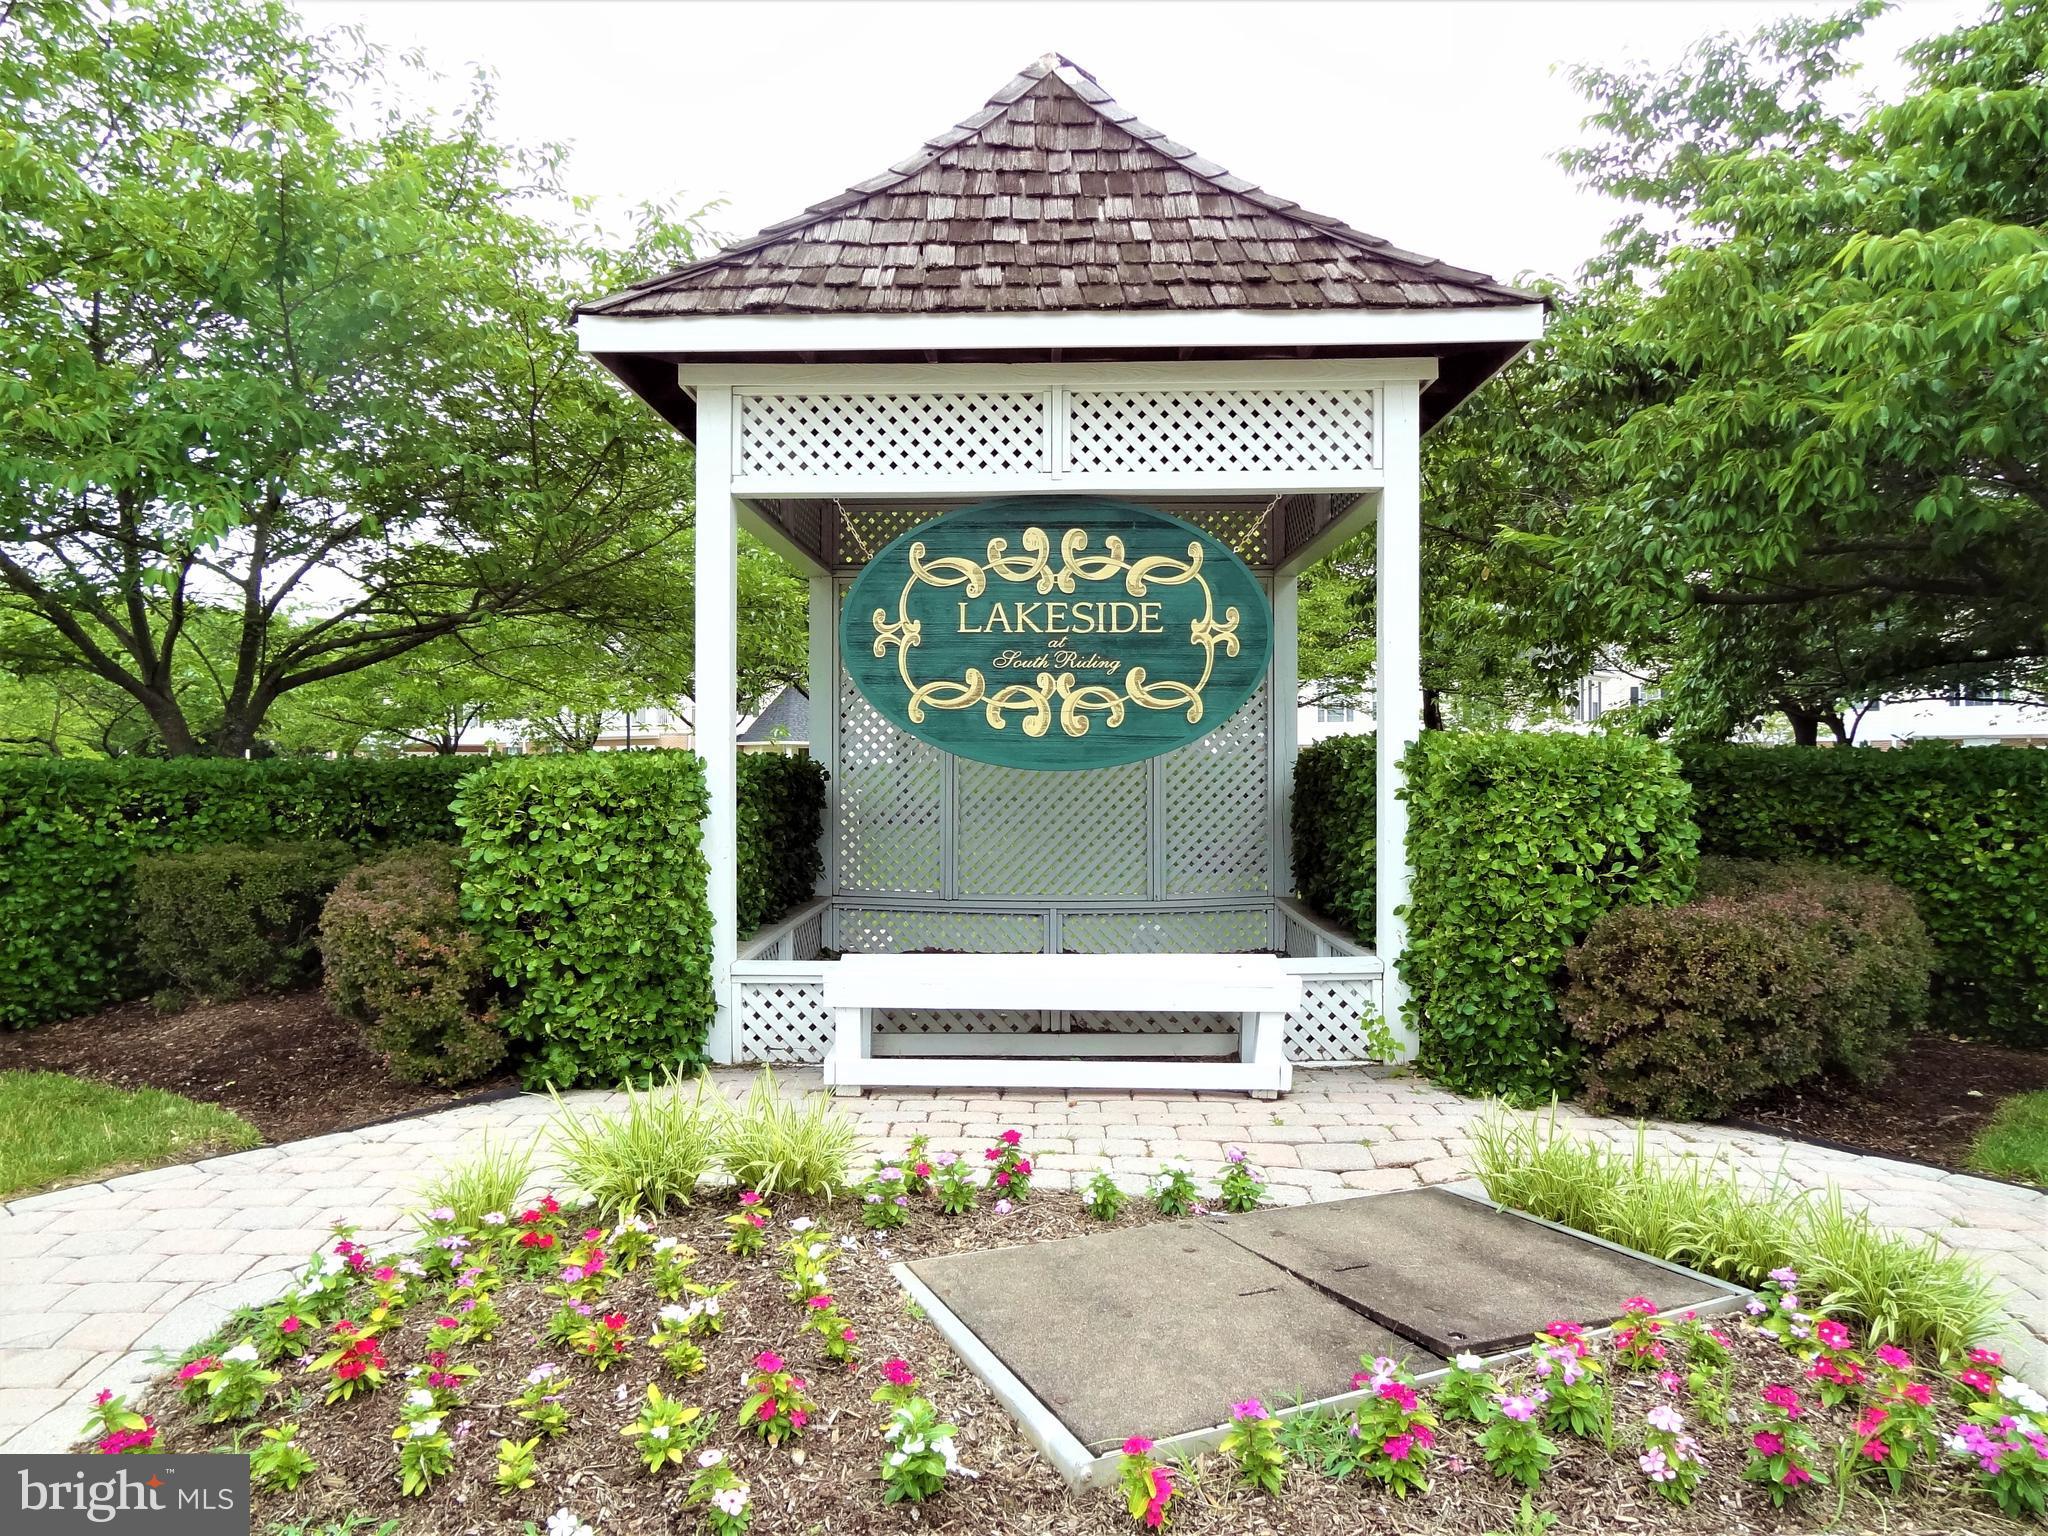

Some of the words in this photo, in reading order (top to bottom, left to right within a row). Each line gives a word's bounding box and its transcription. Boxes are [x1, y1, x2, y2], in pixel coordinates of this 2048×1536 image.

[957, 602, 1163, 633] LAKESIDE
[1048, 636, 1068, 648] at
[993, 650, 1049, 669] South
[1054, 650, 1121, 675] Riding
